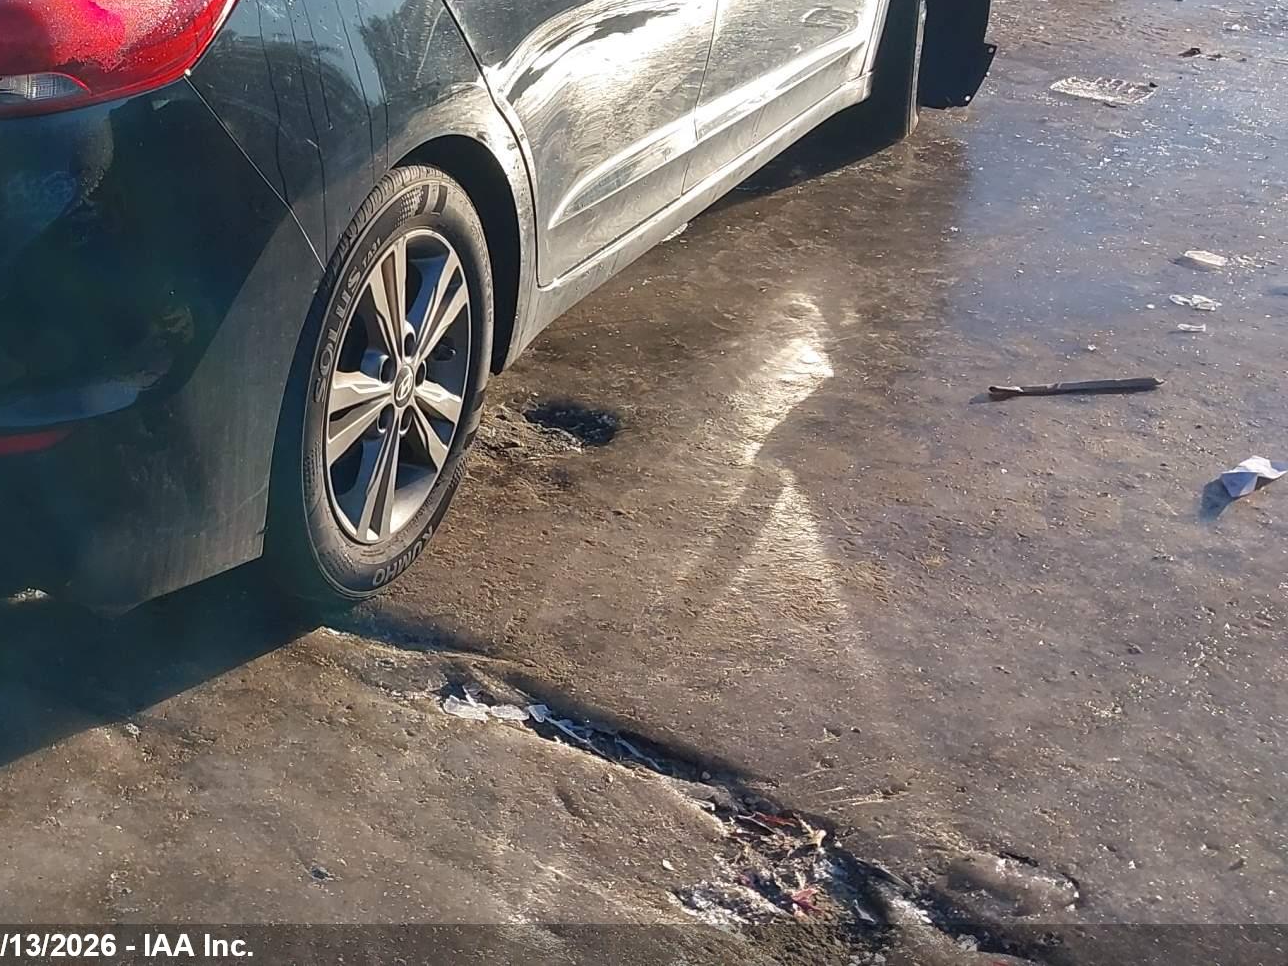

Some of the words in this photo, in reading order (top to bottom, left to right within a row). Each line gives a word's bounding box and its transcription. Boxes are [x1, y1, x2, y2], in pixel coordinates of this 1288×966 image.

[314, 266, 361, 403] SOLUS
[362, 237, 382, 268] TA31
[373, 525, 433, 586] KUMHO
